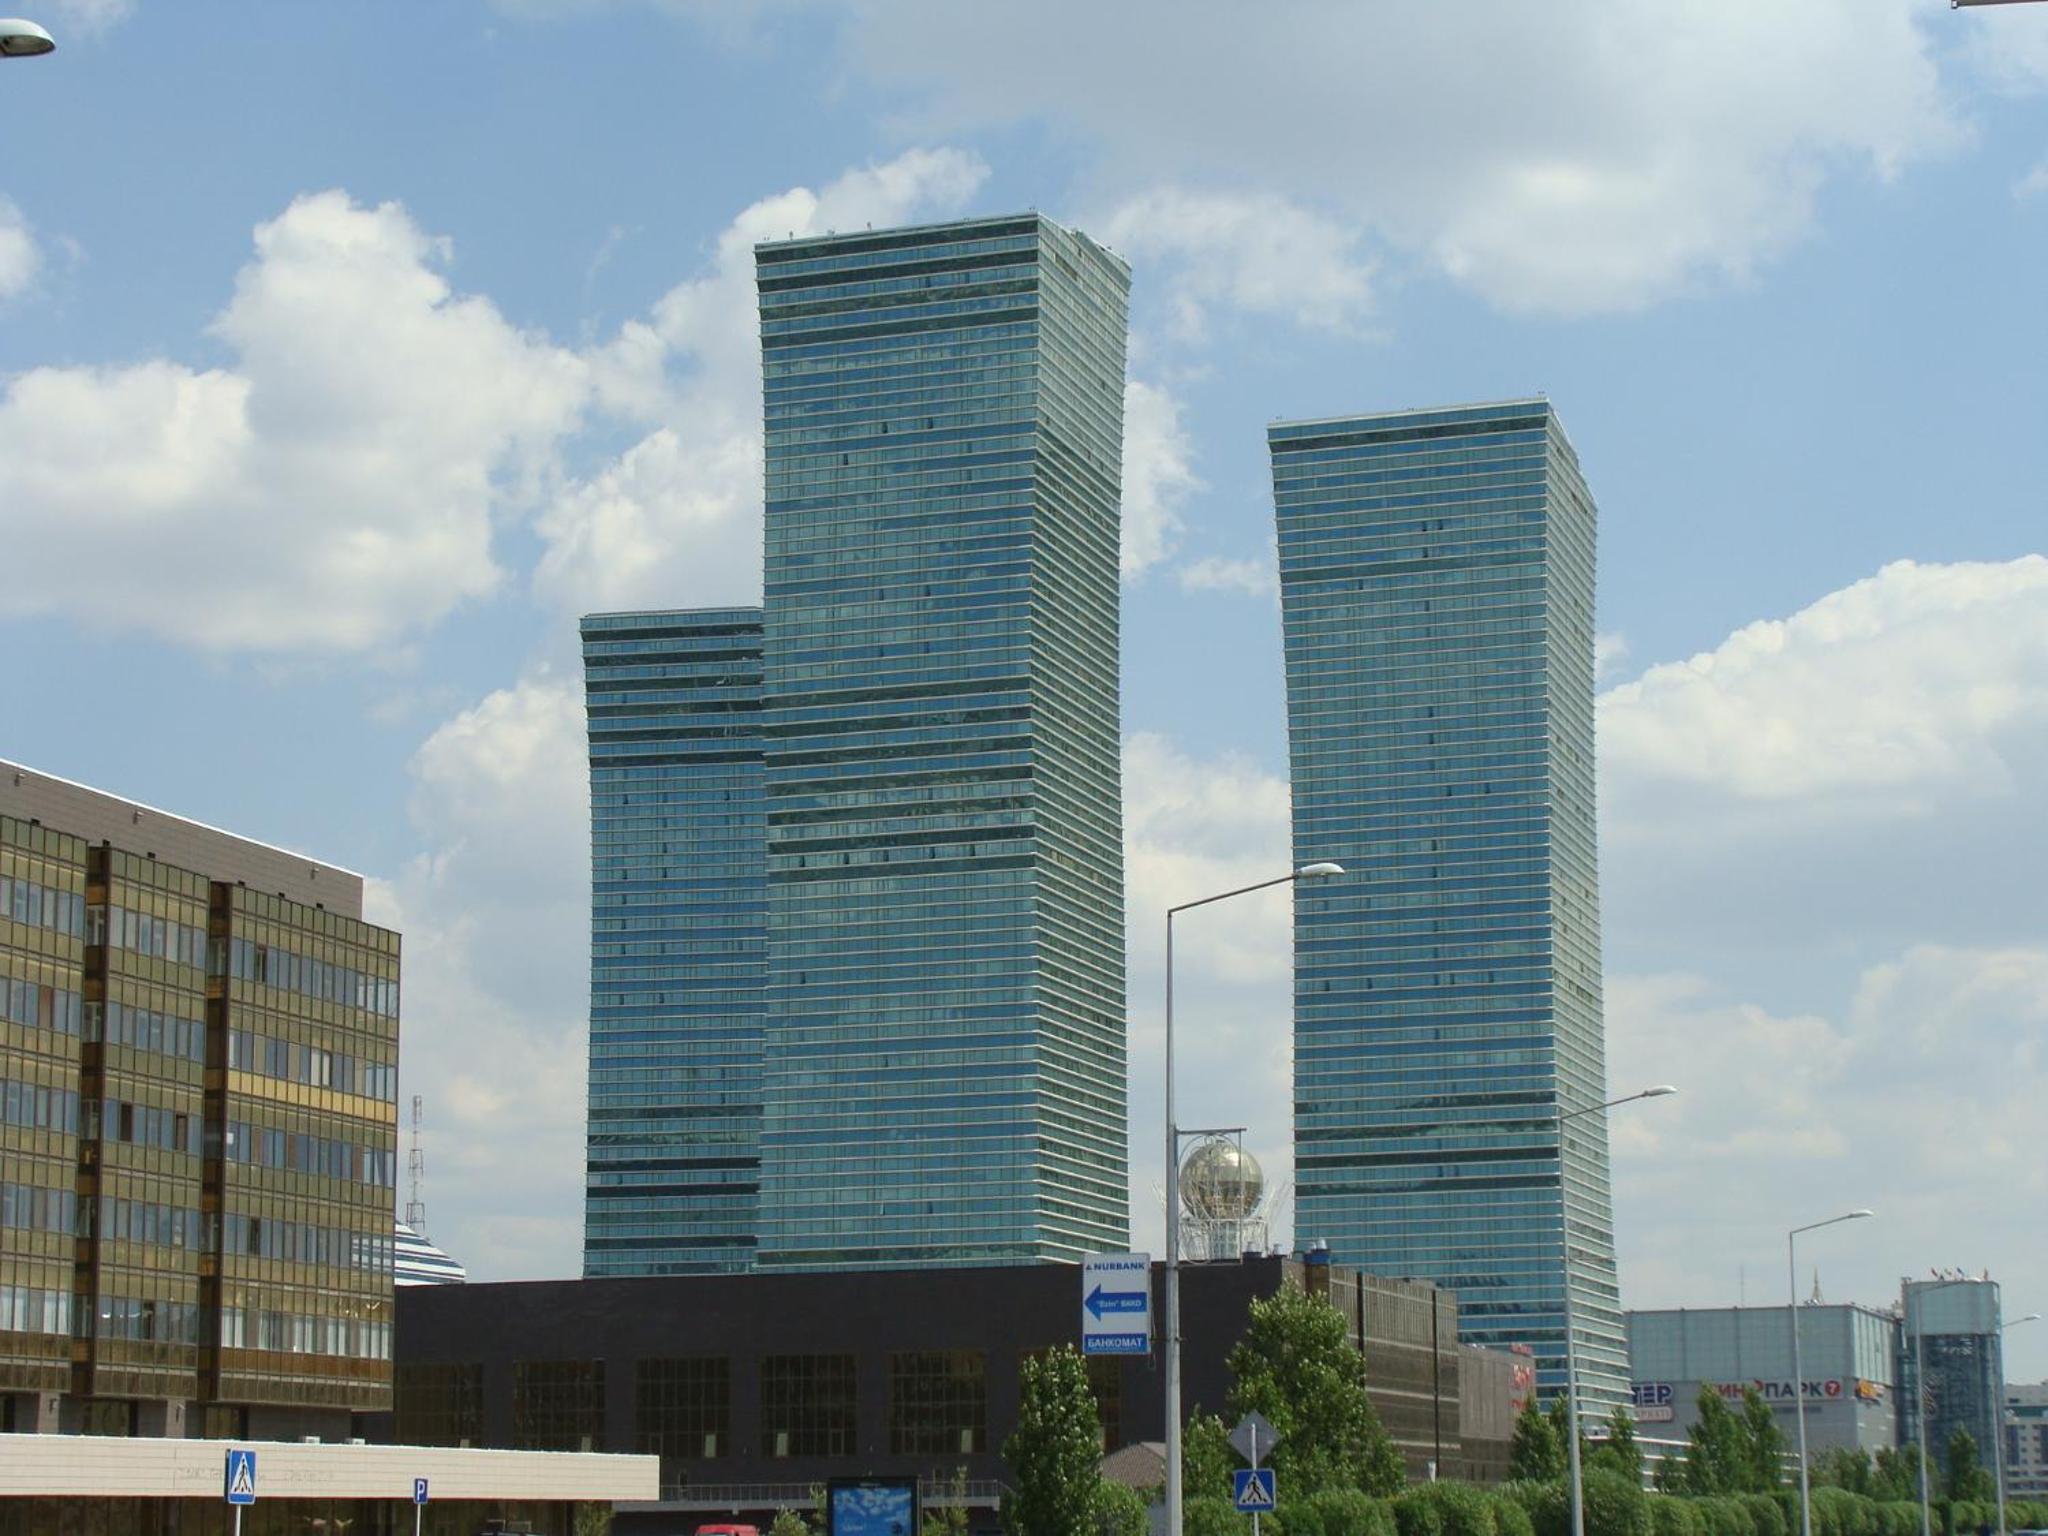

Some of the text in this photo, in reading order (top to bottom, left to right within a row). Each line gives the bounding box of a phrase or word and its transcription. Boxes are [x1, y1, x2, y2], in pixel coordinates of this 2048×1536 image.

[1093, 1262, 1145, 1271] NURBANK
[1088, 1337, 1143, 1347] БАНКОМАТ
[1711, 1377, 1823, 1398] ИНПАРК
[417, 1481, 425, 1501] P
